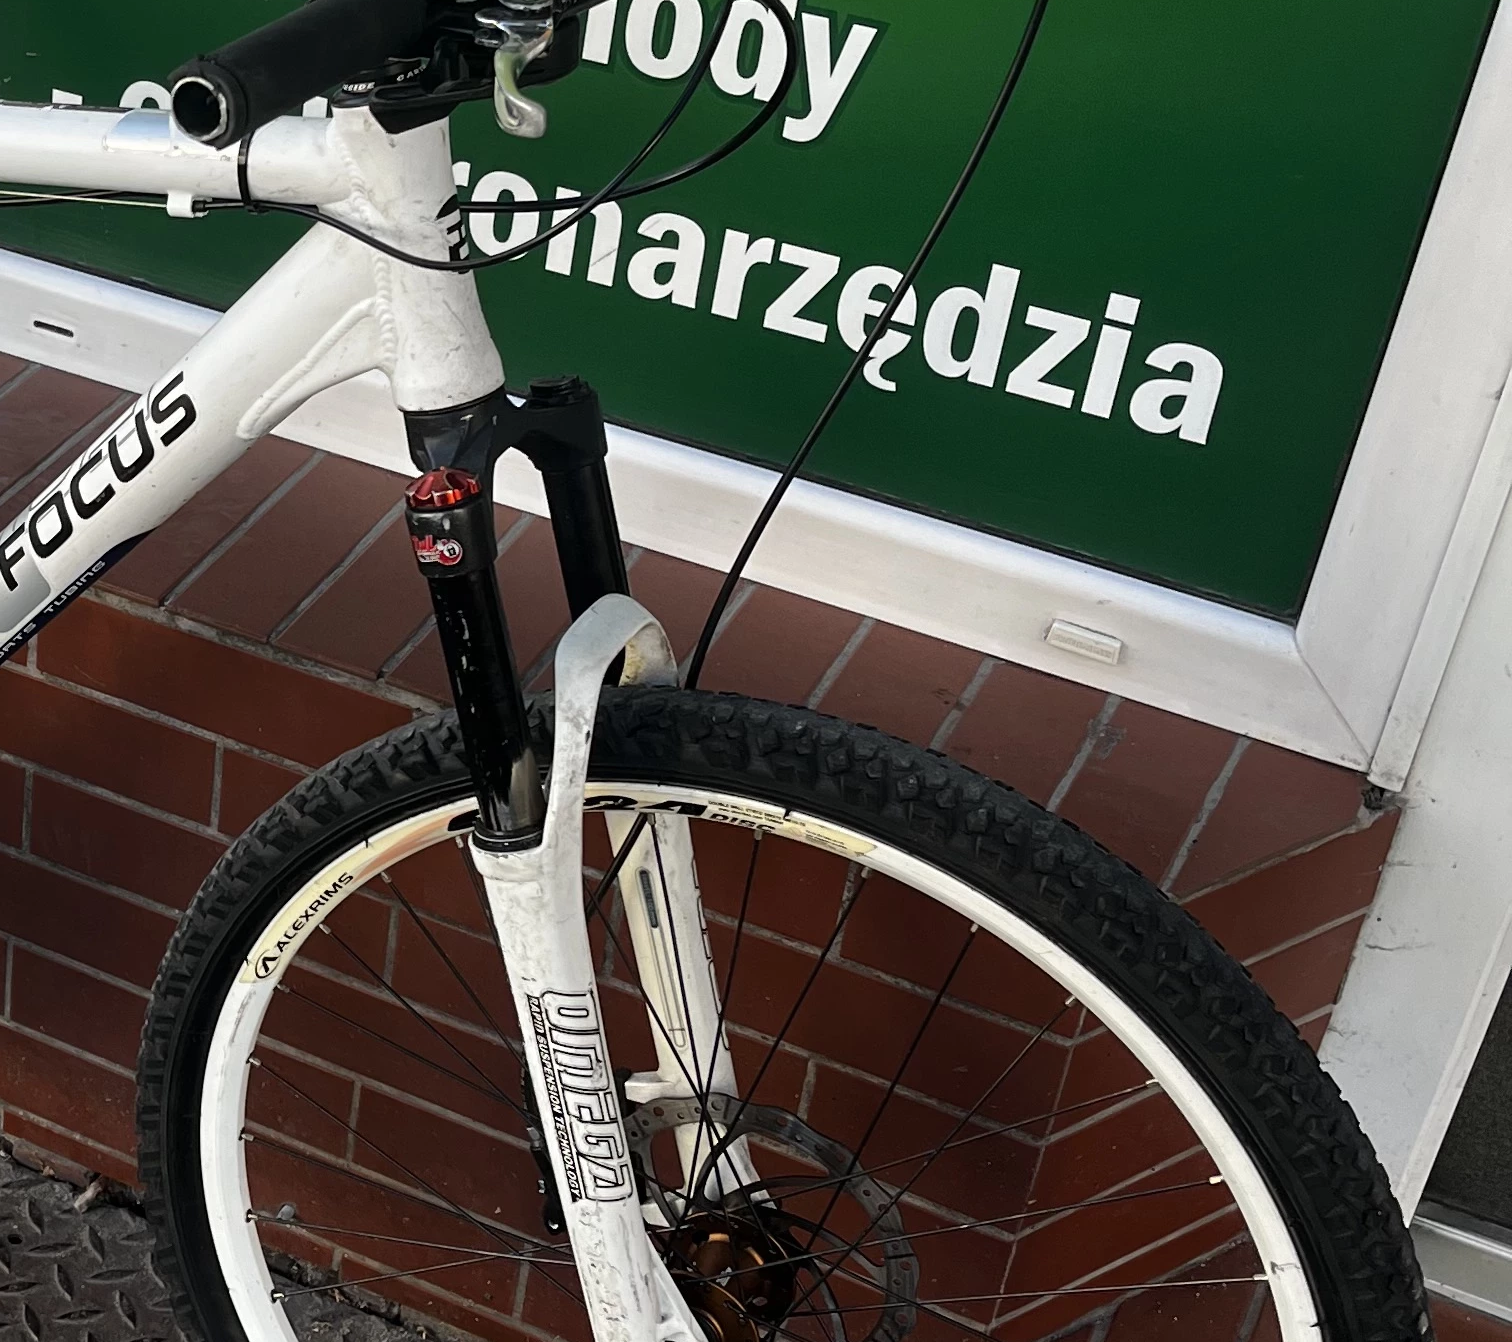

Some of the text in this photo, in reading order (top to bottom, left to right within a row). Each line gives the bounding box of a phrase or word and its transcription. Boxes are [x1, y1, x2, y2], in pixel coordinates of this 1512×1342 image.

[43, 560, 107, 615] TUBING
[274, 871, 354, 953] ALEXRIMS
[529, 995, 582, 1199] RAPID SUSPENSION TECHNOLOGY
